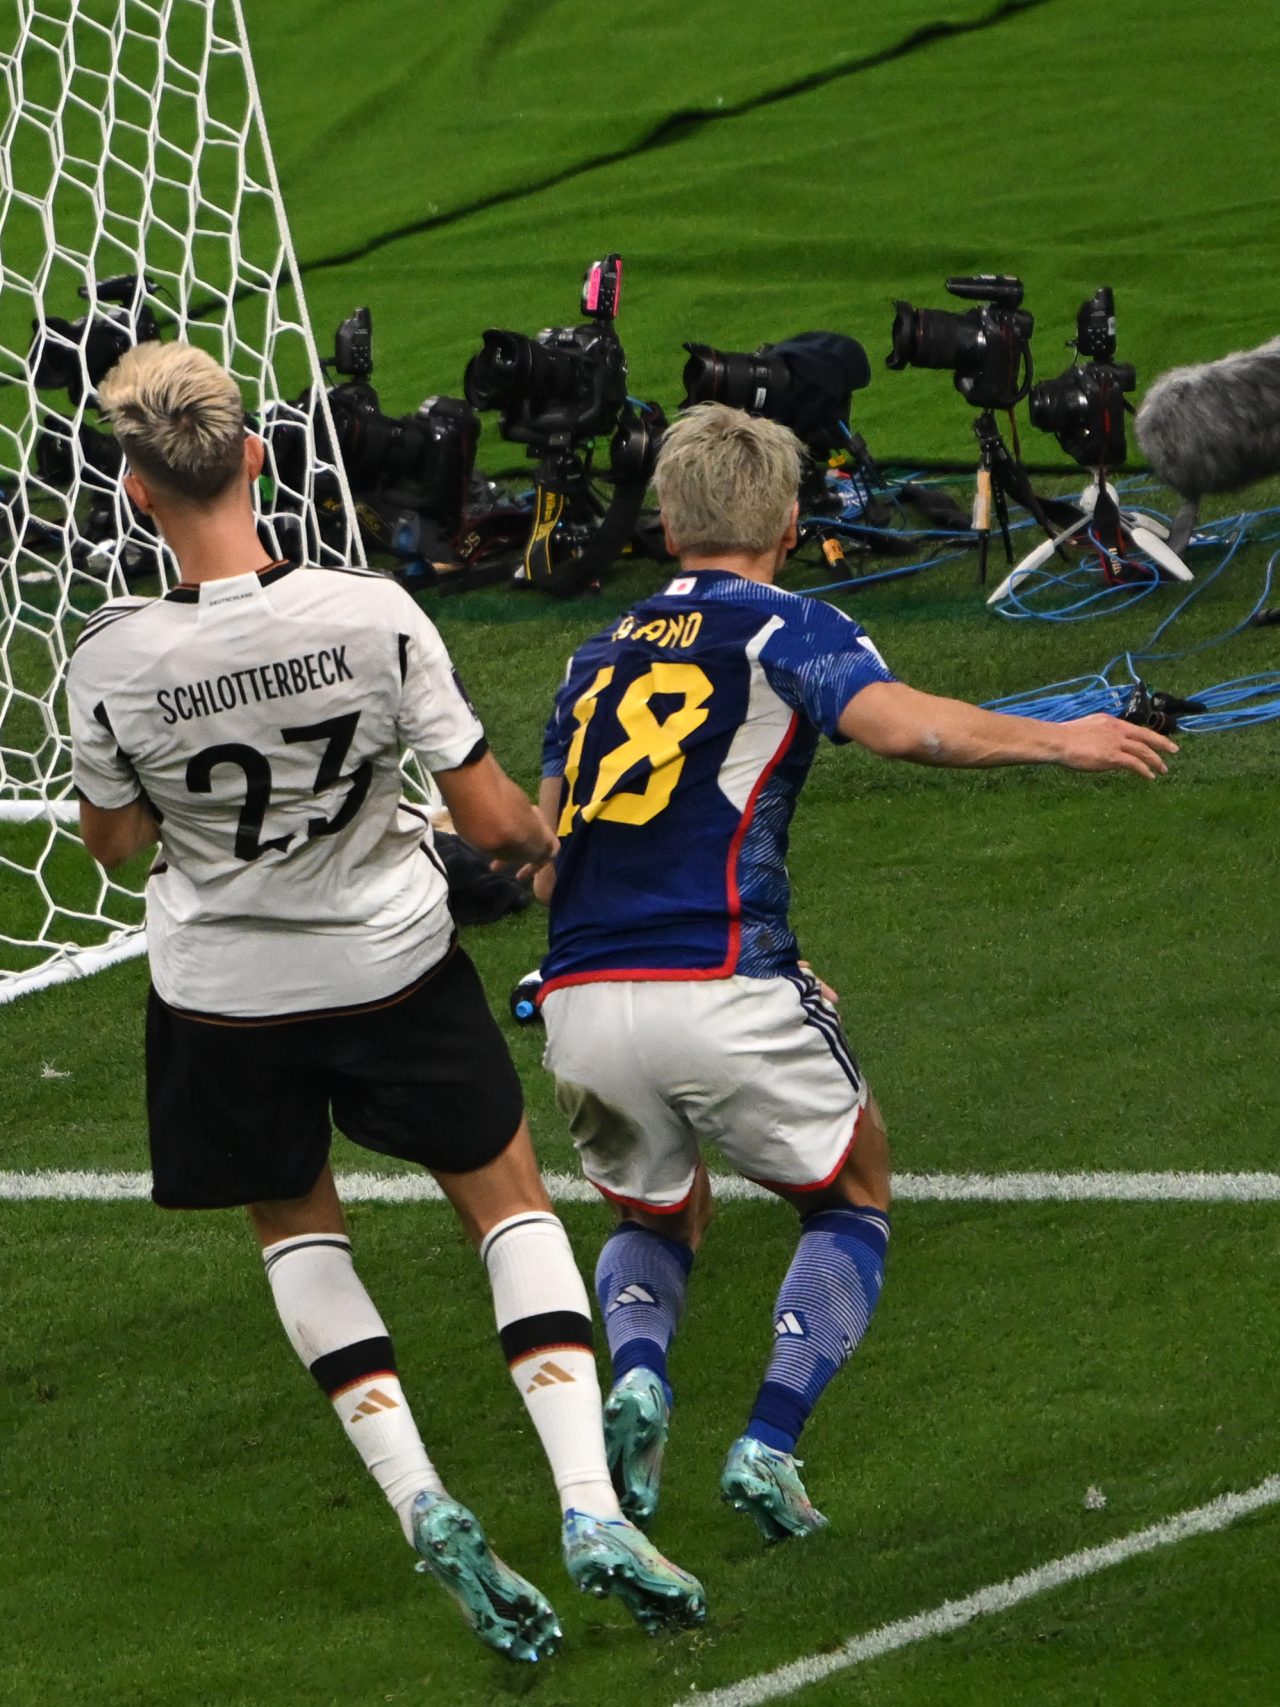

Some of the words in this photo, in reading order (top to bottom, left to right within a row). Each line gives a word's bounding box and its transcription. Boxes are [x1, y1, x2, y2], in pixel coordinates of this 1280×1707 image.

[156, 645, 354, 725] SCHLOTTERBECK
[557, 662, 715, 837] 18
[185, 710, 373, 863] 23
